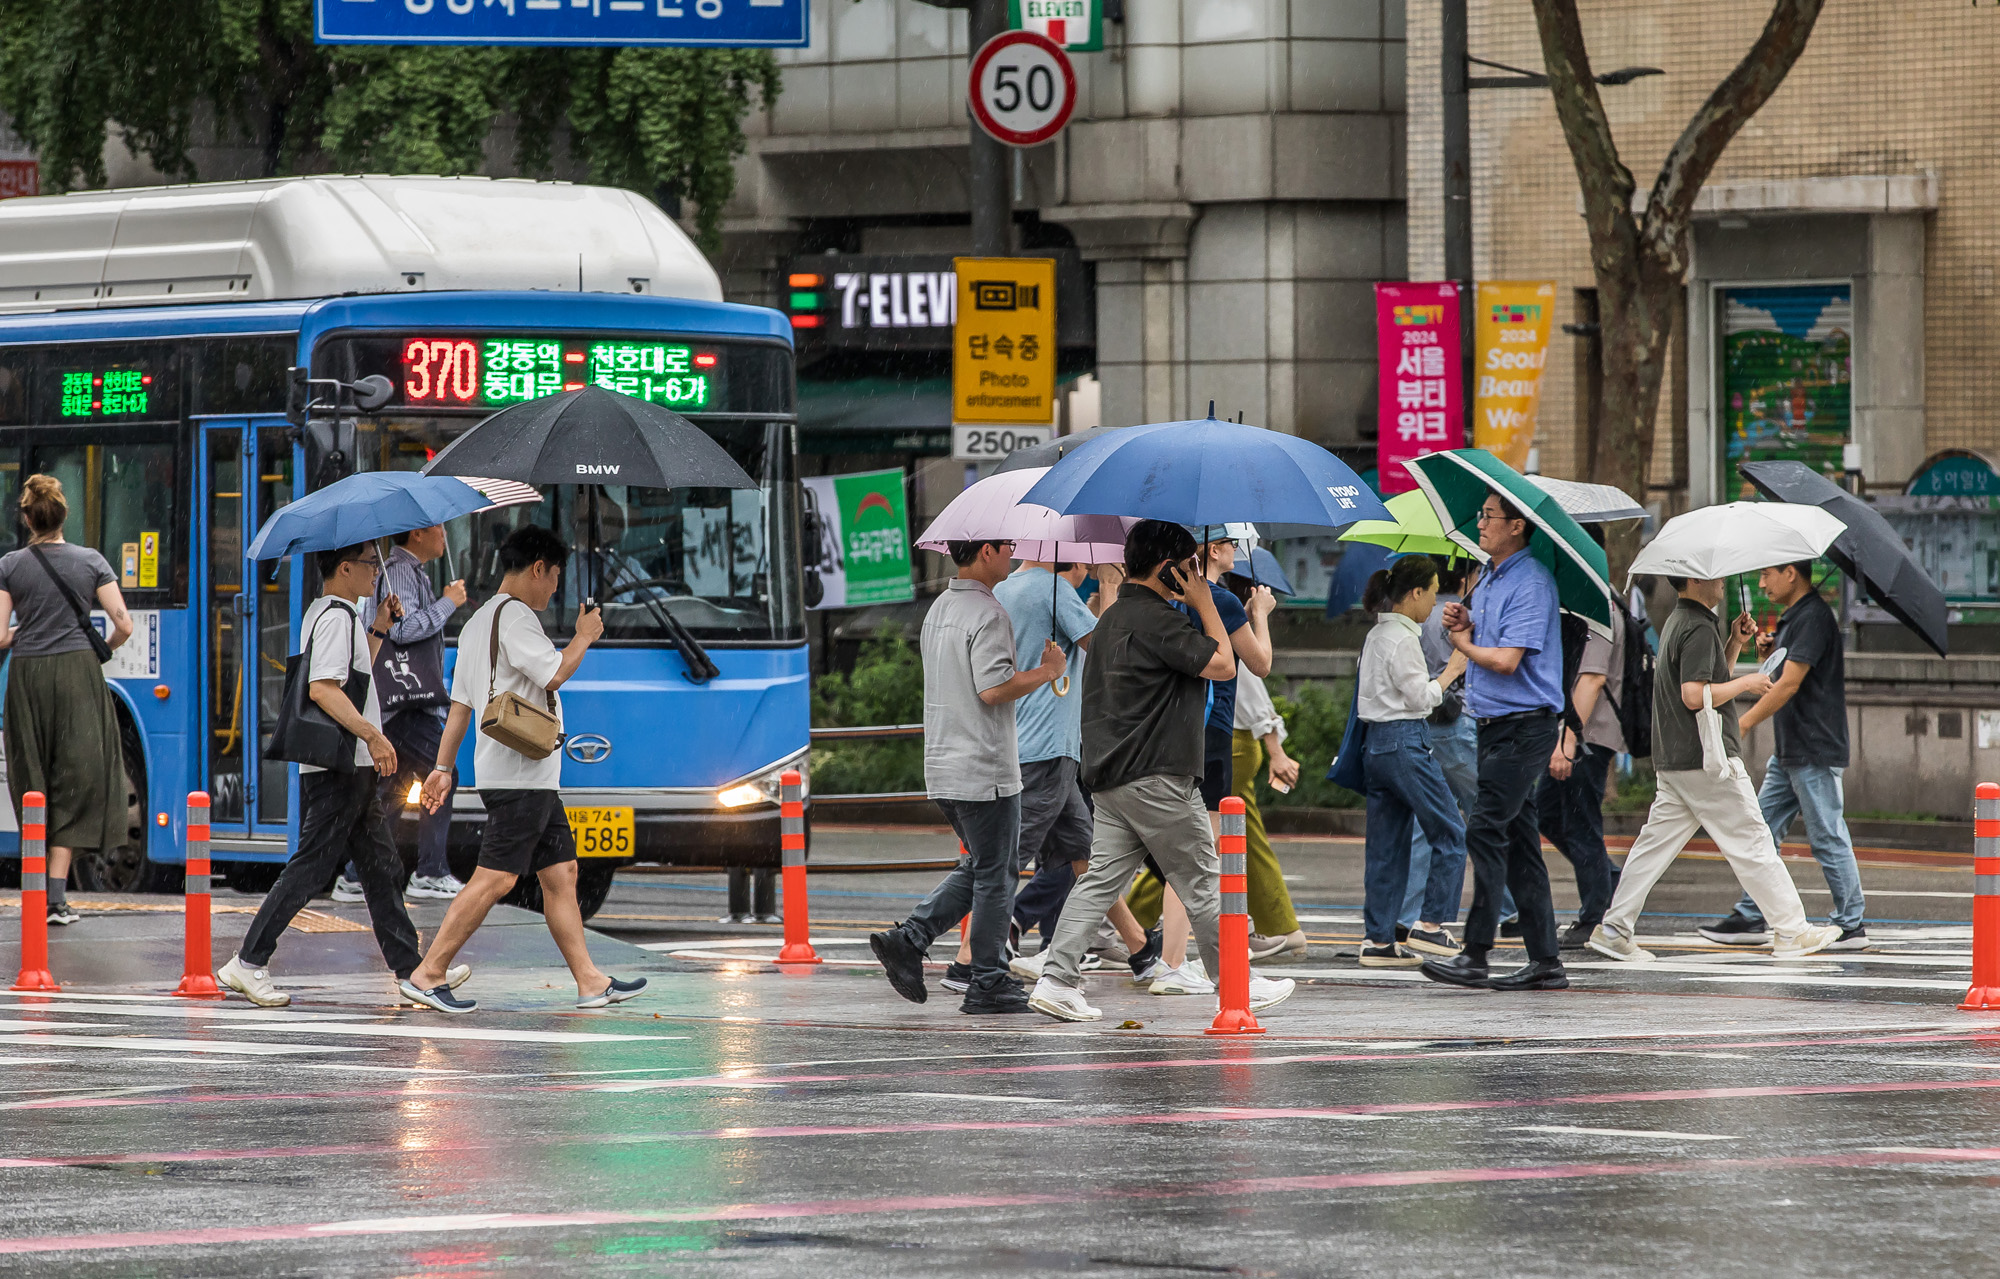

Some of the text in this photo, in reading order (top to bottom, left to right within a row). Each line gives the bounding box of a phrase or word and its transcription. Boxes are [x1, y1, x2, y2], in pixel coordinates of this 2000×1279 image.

[993, 64, 1055, 112] 50
[833, 272, 957, 328] 7-ELEV
[968, 334, 1040, 361] 단속중
[1402, 331, 1438, 345] 2024
[1500, 329, 1538, 343] 2024
[485, 341, 560, 371] 강동역
[592, 345, 690, 374] 천호대로
[1396, 347, 1445, 377] 서울
[1485, 347, 1547, 369] Seoul
[406, 341, 477, 398] 370
[979, 370, 1030, 388] Photo
[62, 372, 92, 394] 강동역
[103, 371, 142, 393] 천호대로
[484, 371, 562, 400] 동대문
[1397, 379, 1447, 409] 뷰티
[62, 394, 92, 416] 동대문
[102, 392, 148, 415] 종로1-6가
[966, 393, 1042, 408] enforcement
[1396, 411, 1448, 441] 위크
[966, 431, 1040, 454] 250m
[576, 464, 620, 475] BMW
[1326, 485, 1360, 498] KYOBO
[1335, 497, 1357, 509] LIFE
[568, 810, 612, 823] 서울 74
[571, 827, 629, 853] 1585
